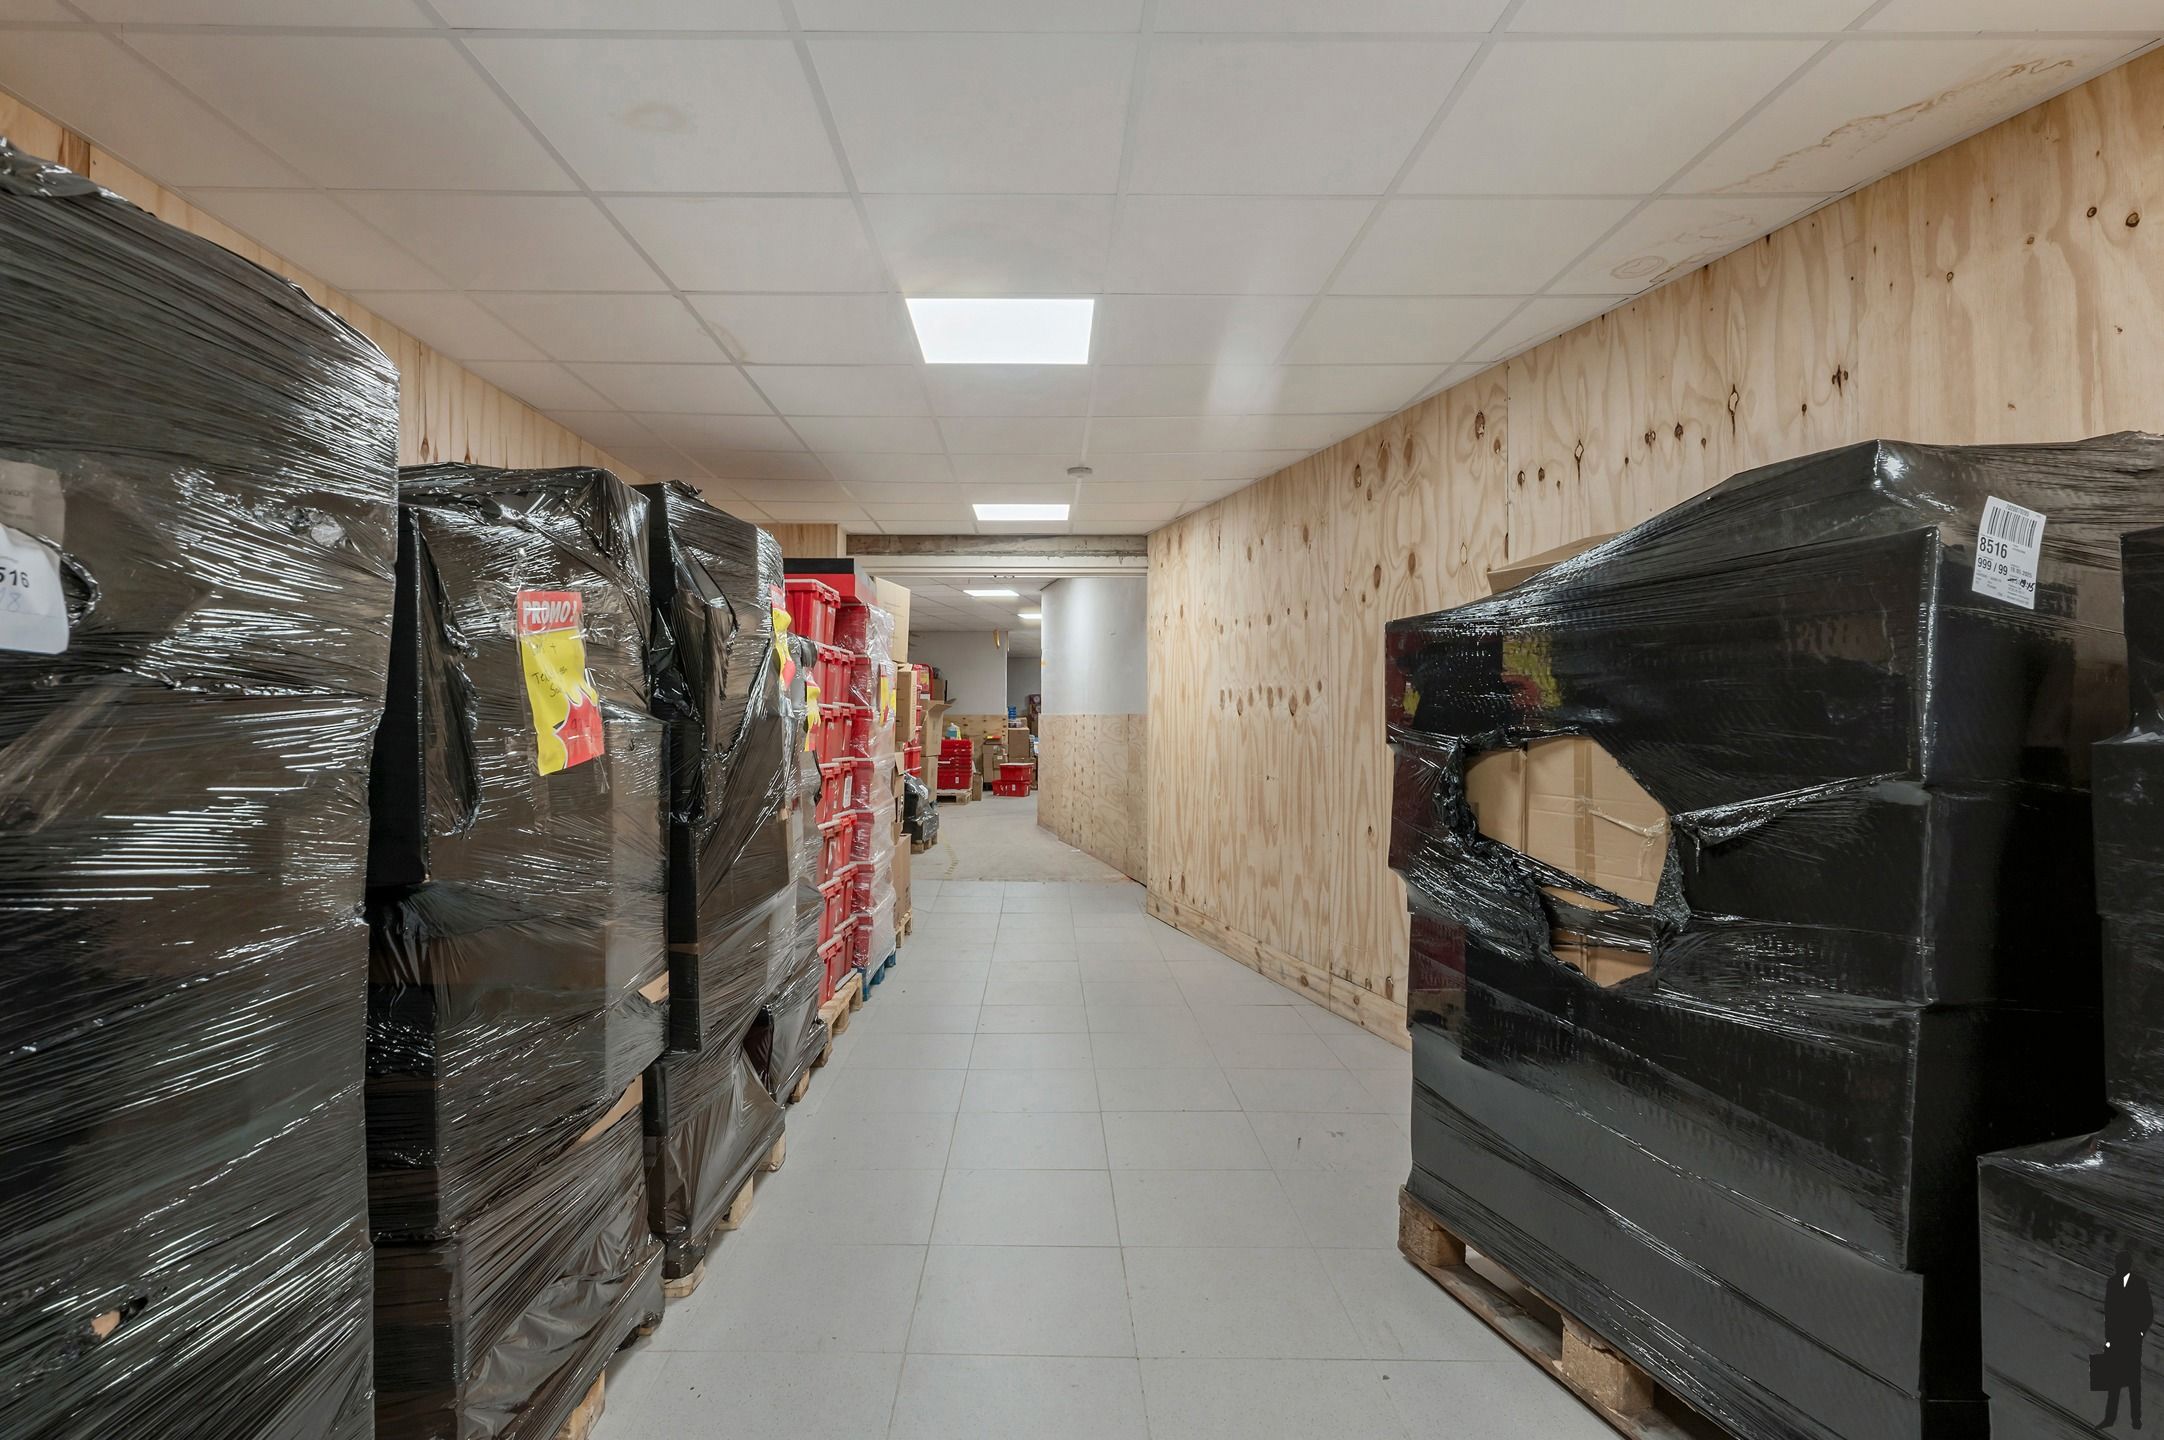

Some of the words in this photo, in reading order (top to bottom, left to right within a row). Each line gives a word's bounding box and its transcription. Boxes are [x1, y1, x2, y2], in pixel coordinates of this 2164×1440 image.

[1979, 536, 2008, 559] 8516
[1977, 557, 1992, 571] 999
[1998, 564, 2008, 576] 99
